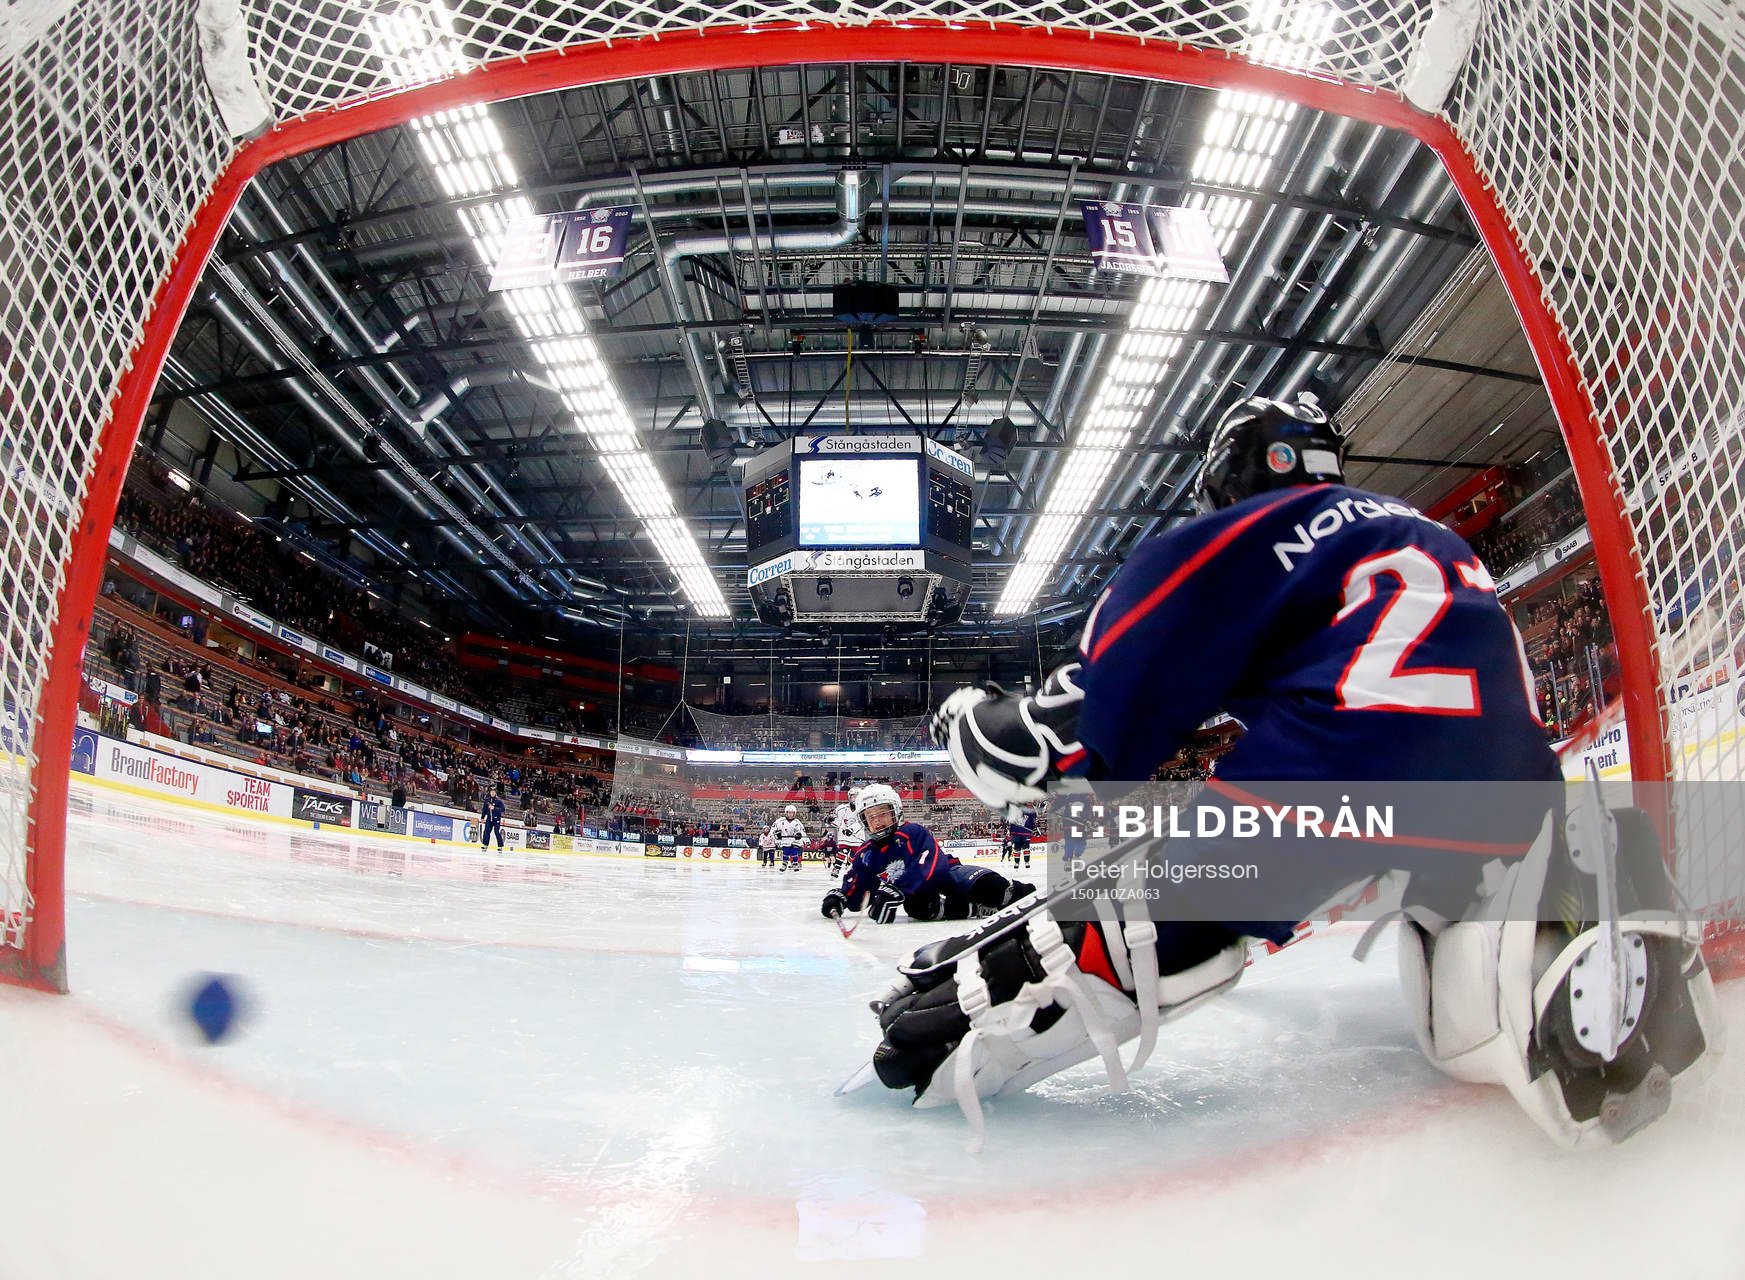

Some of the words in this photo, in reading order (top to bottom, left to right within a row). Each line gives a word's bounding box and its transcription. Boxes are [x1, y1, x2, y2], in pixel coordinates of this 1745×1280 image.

[576, 225, 613, 255] 16
[1101, 219, 1137, 248] 15
[568, 268, 608, 280] HELBER
[826, 437, 912, 452] Stångåstaden
[1562, 539, 1578, 554] SAAB
[749, 557, 793, 585] Corren
[111, 747, 199, 795] BrandFactory
[244, 777, 271, 796] TEAM
[226, 790, 269, 813] SPORTIA
[302, 794, 345, 815] TACKS
[506, 831, 520, 841] SAAB
[657, 835, 675, 843] PEMA
[692, 837, 709, 845] PEMA
